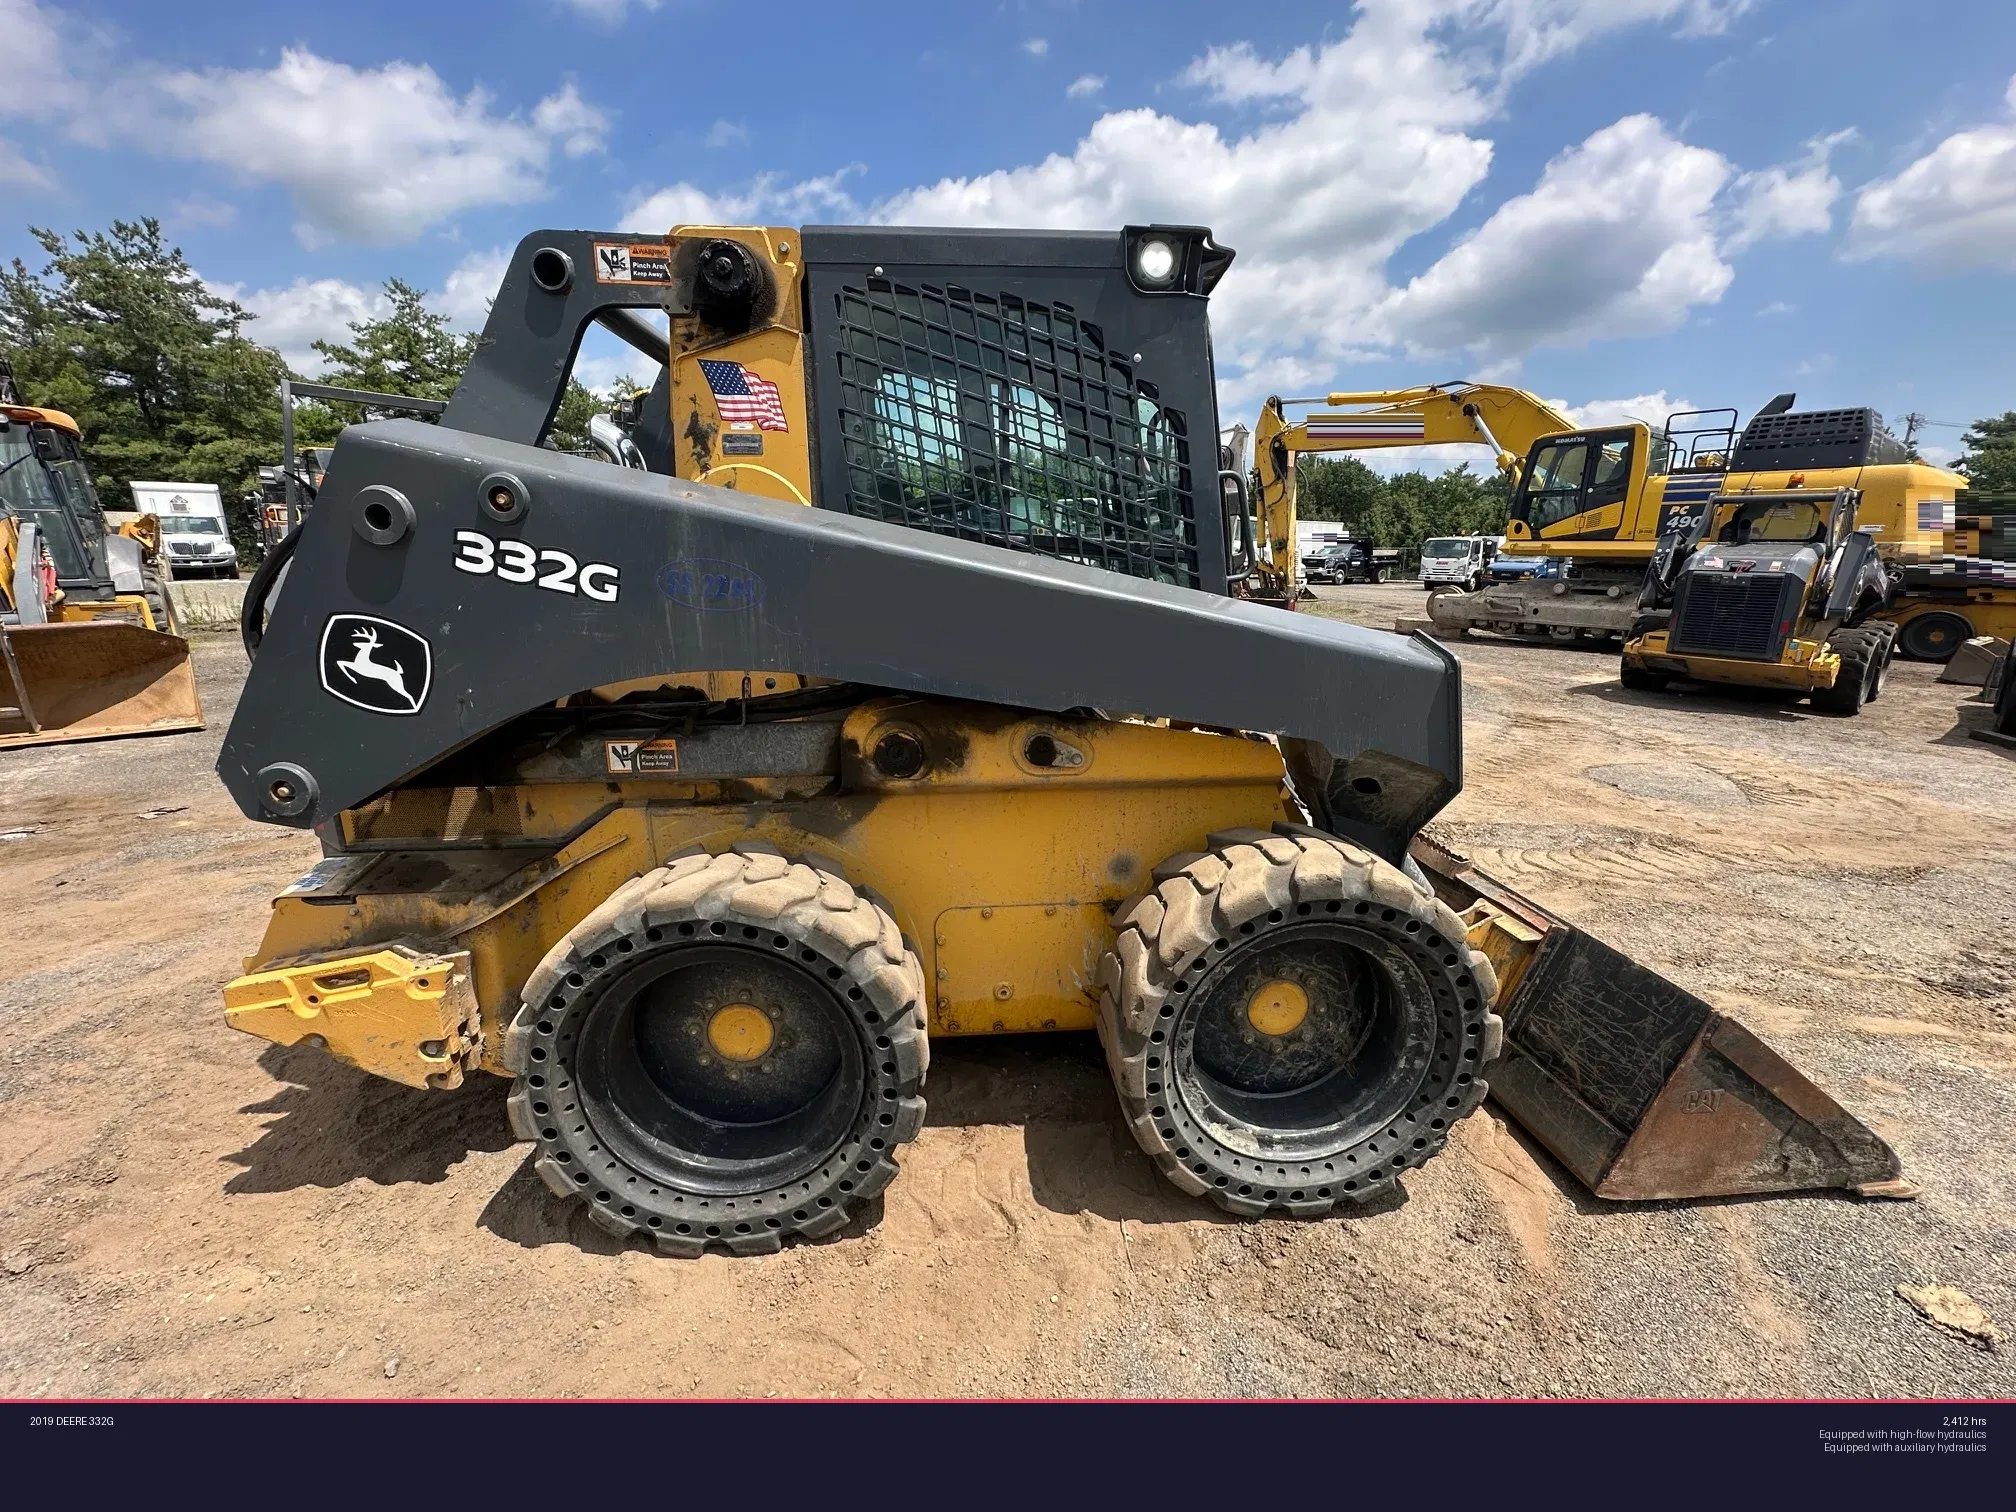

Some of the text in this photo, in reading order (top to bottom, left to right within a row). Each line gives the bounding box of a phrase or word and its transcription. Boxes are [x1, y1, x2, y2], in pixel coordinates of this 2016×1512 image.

[639, 248, 667, 256] WARNING
[632, 261, 651, 269] Pinch
[633, 270, 663, 279] Keep Away
[1555, 436, 1586, 444] KOMATSU
[1669, 505, 1690, 515] PC
[1666, 516, 1703, 528] 490
[454, 530, 619, 602] 332G
[1685, 1089, 1725, 1112] CAT
